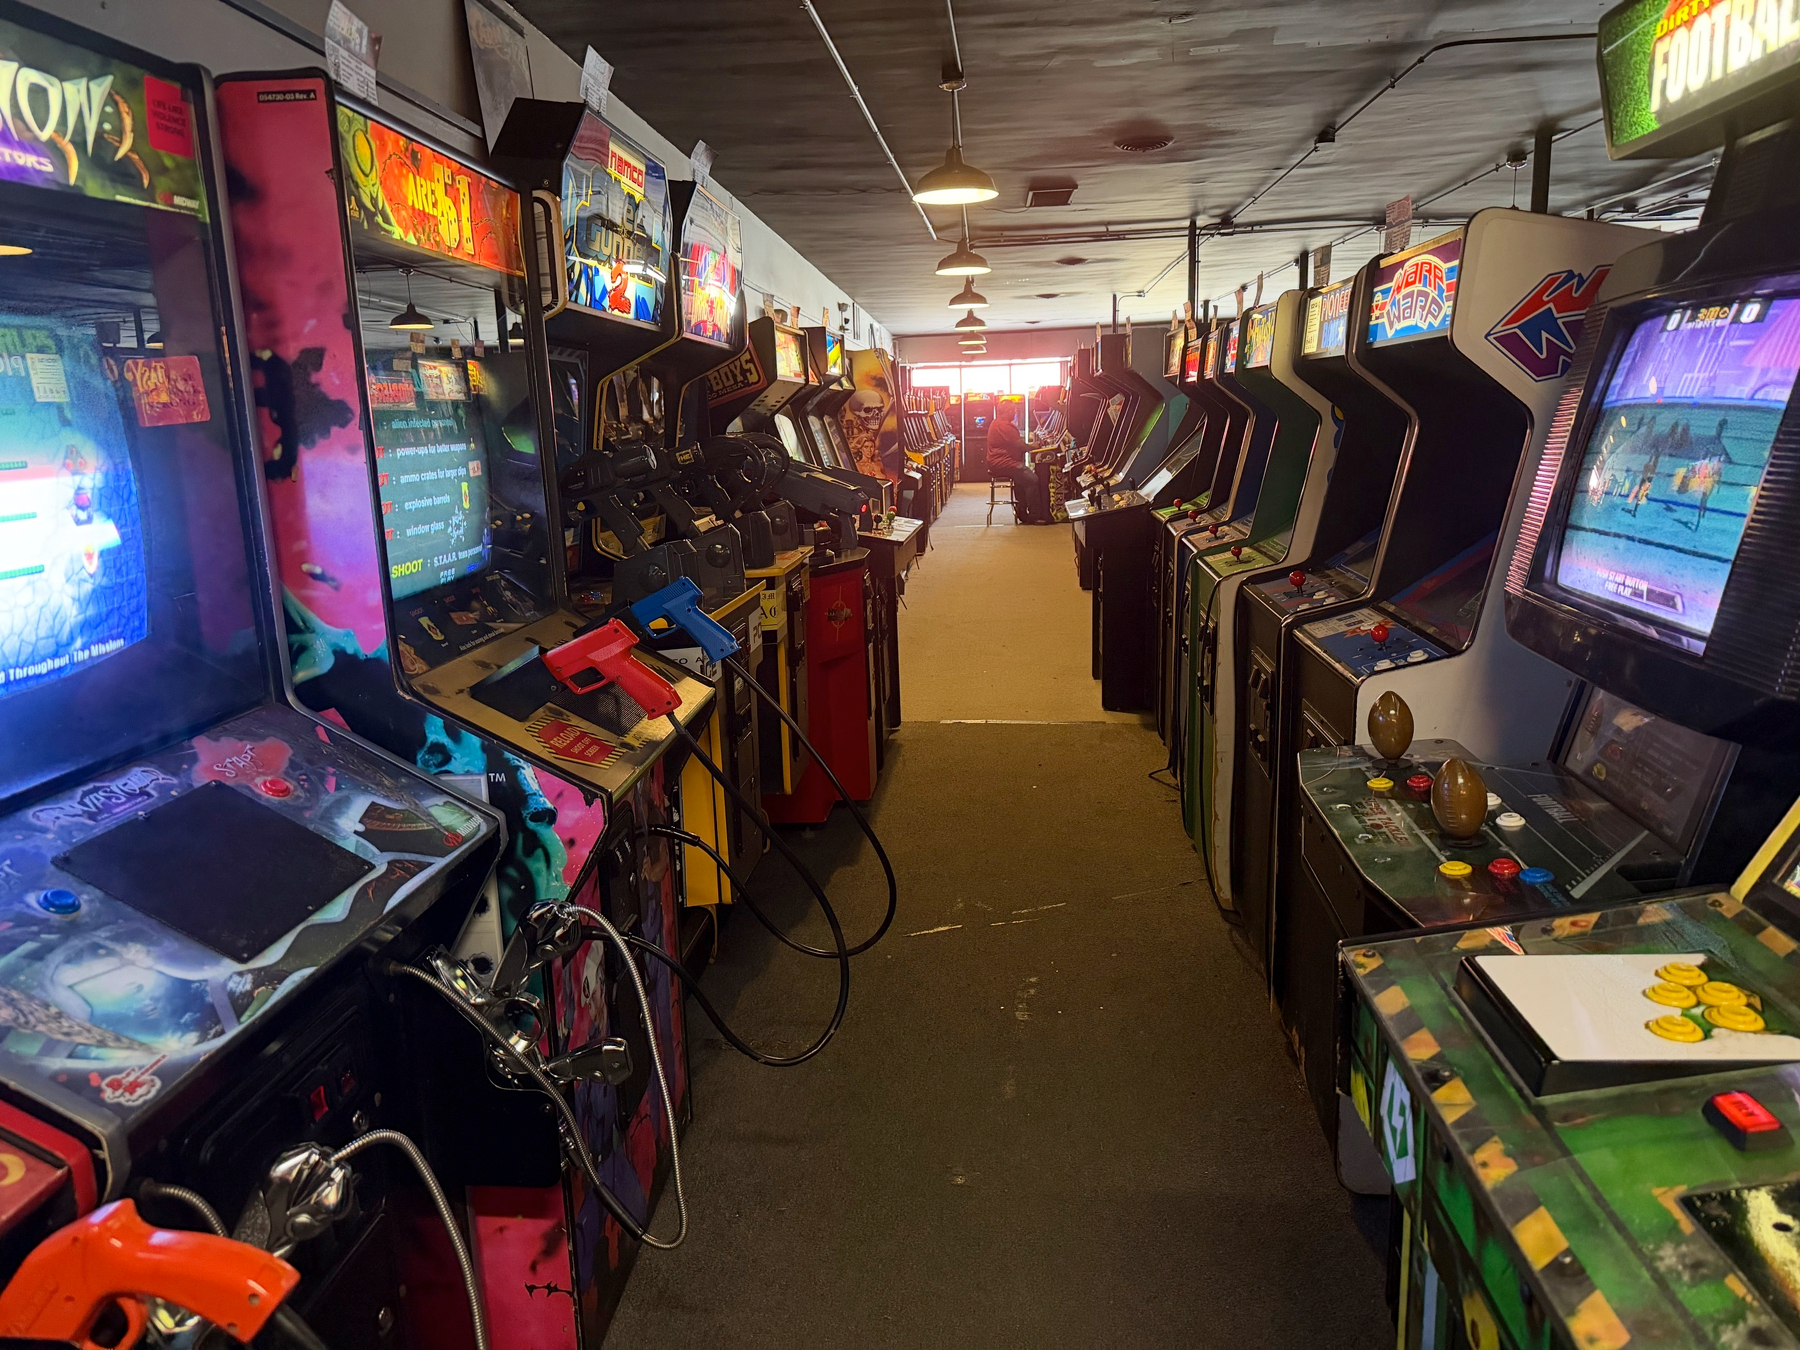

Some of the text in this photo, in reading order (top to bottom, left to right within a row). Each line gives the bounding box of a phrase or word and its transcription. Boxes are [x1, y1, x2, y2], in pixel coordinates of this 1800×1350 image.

[610, 150, 645, 188] namco
[708, 350, 759, 391] BOYS
[396, 446, 428, 458] power-ups
[400, 473, 420, 484] ammo
[404, 496, 433, 511] explosive
[433, 494, 450, 506] barrels
[406, 524, 430, 537] window
[430, 521, 444, 534] glass
[391, 558, 423, 579] SHOOT
[440, 568, 456, 578] FREE
[440, 576, 455, 584] PLAY
[1604, 581, 1633, 597] FREE PLAY
[8, 653, 70, 681] Throughout
[73, 648, 90, 663] The
[90, 638, 125, 657] Missions
[549, 726, 581, 749] RELOAD
[488, 773, 506, 782] TM
[456, 814, 484, 837] MIDWAY
